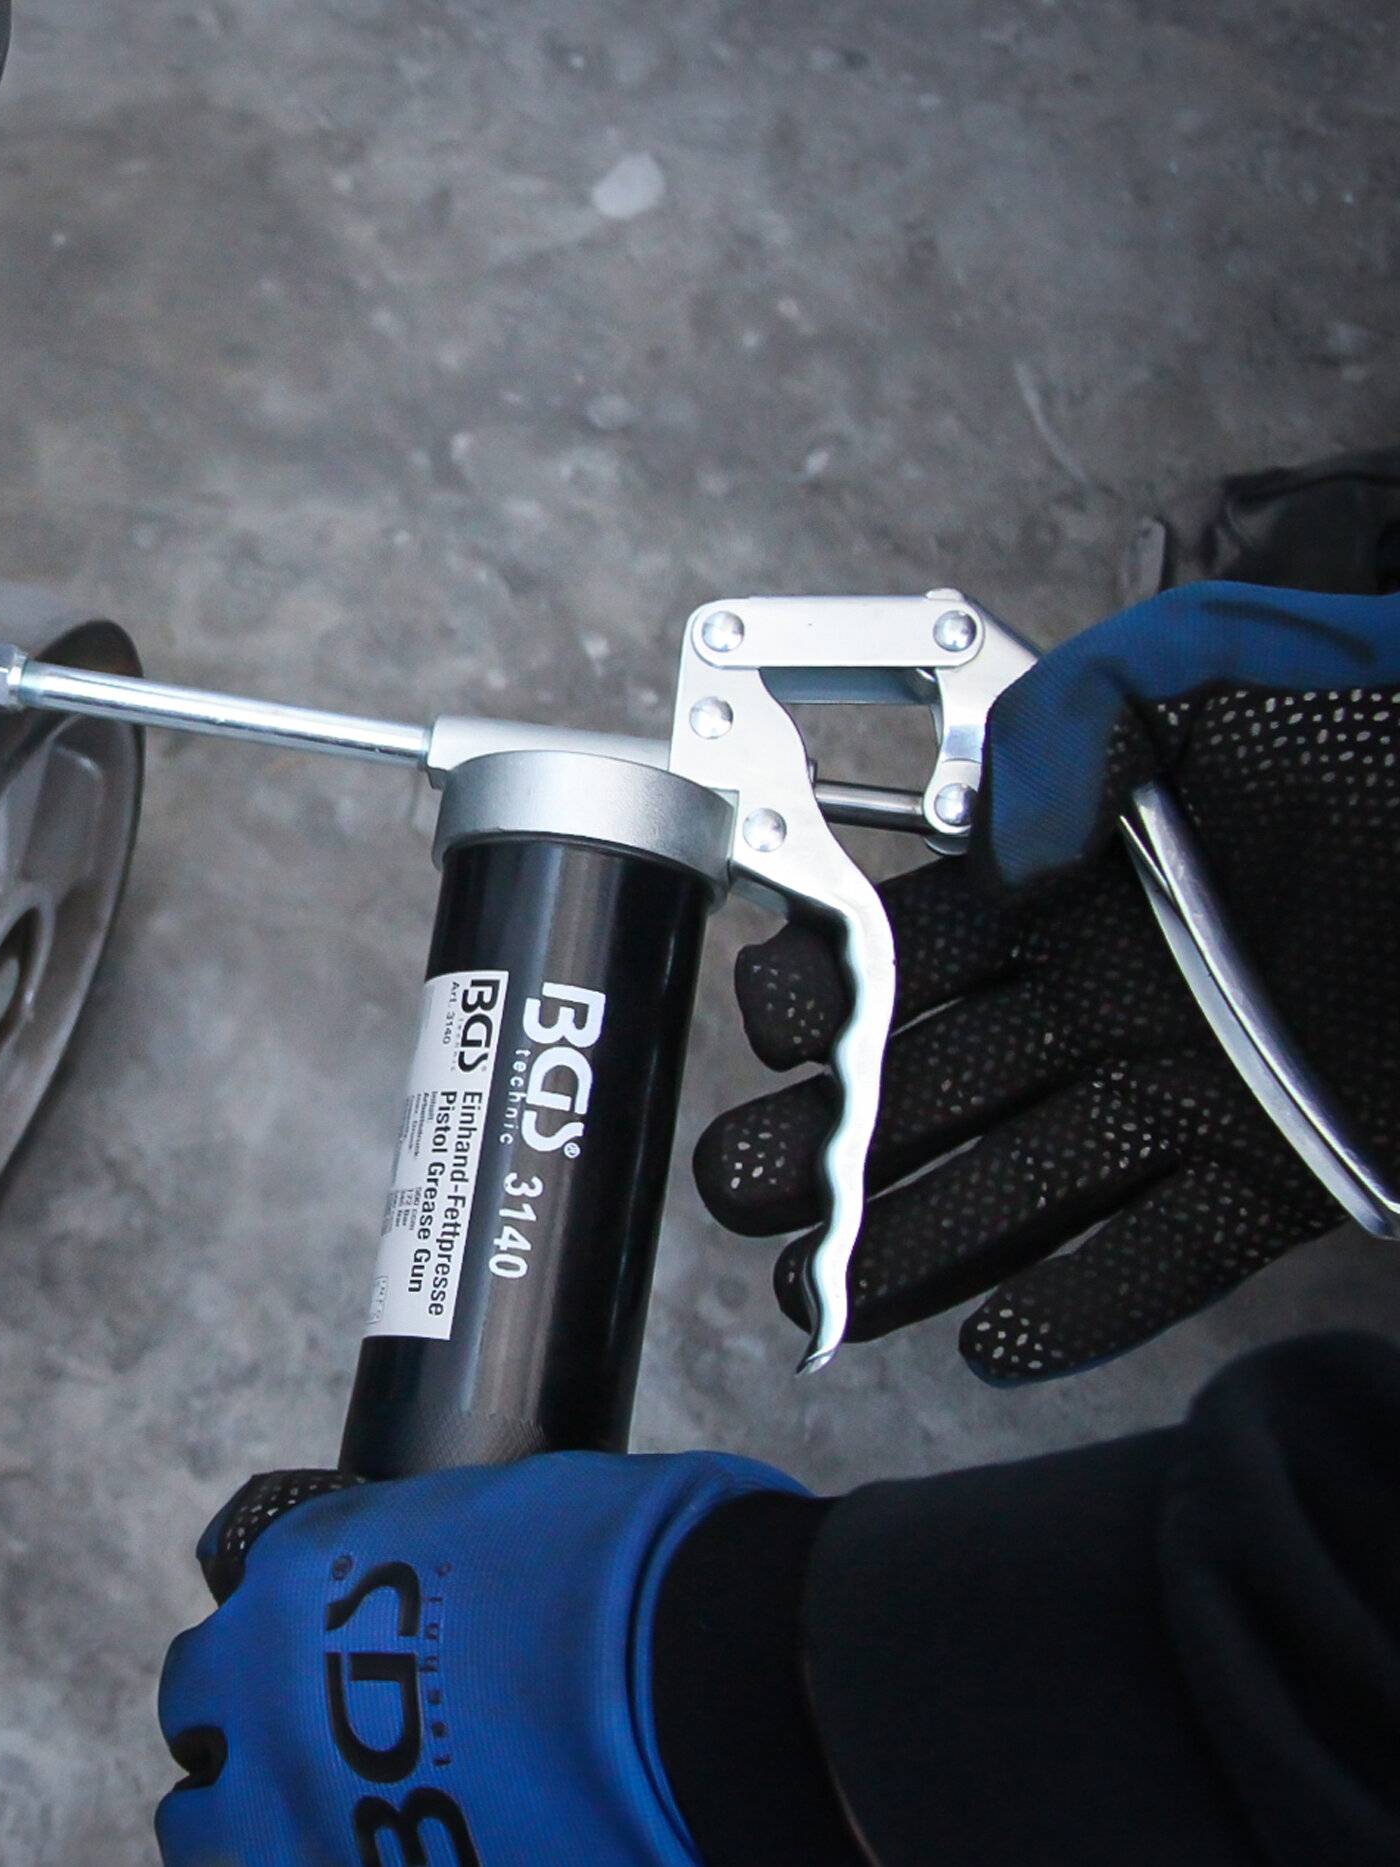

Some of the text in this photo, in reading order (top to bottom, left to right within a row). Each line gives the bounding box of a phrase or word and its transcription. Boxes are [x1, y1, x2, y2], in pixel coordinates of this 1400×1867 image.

[442, 1011, 456, 1045] 3140
[500, 1049, 532, 1146] technic
[408, 1091, 458, 1293] Pistol Grease Gun
[429, 1091, 483, 1316] Einhand-Fettpresse
[488, 1172, 544, 1279] 3140
